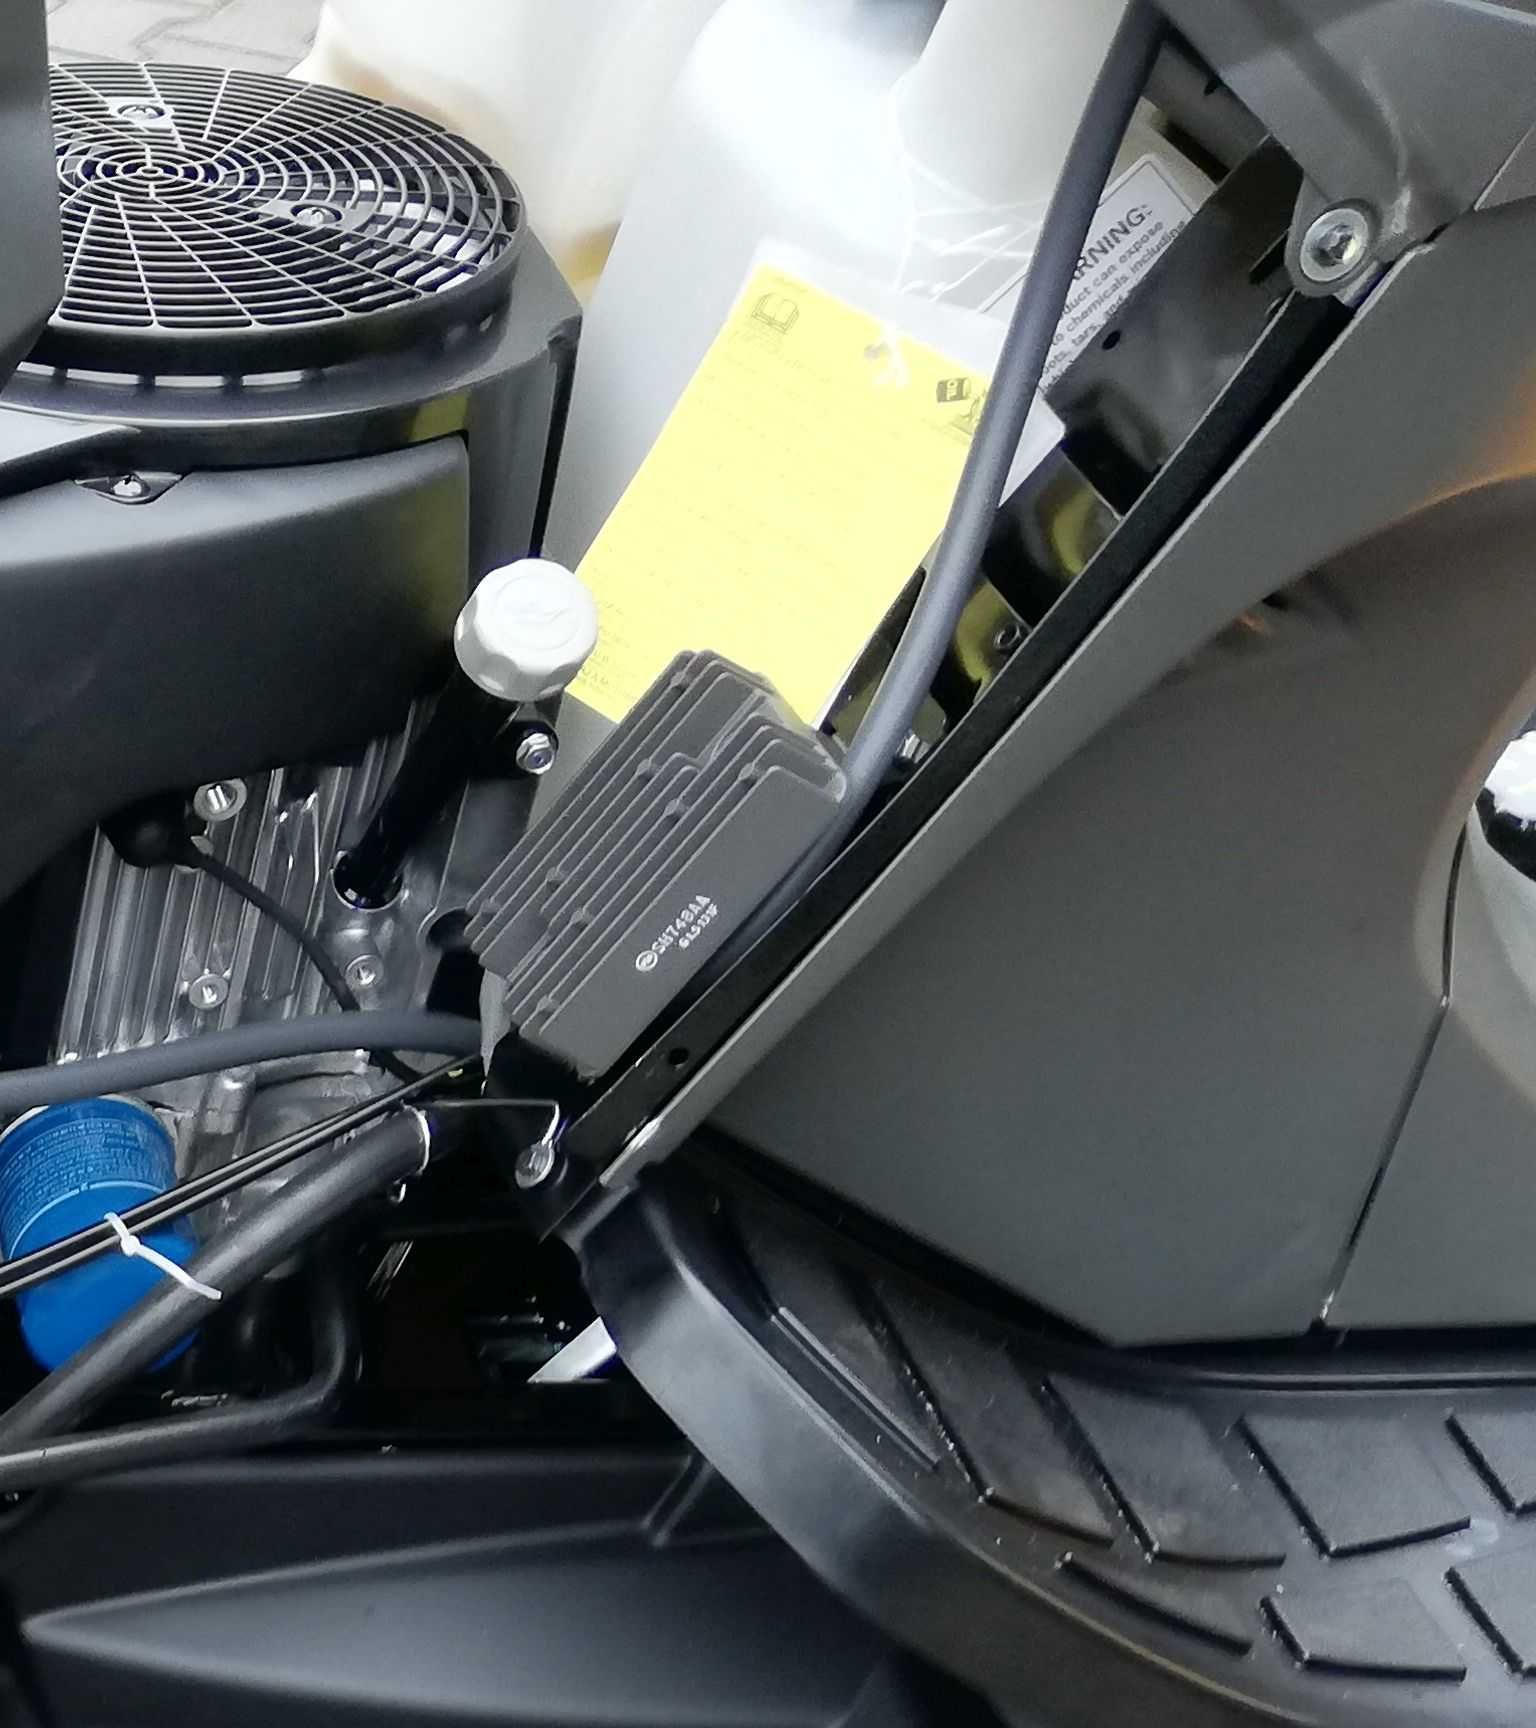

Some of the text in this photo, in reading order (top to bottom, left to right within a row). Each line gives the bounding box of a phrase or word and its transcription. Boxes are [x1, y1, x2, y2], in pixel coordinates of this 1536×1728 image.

[1093, 264, 1118, 288] can
[1119, 220, 1164, 265] expose
[1066, 273, 1128, 333] chemicals
